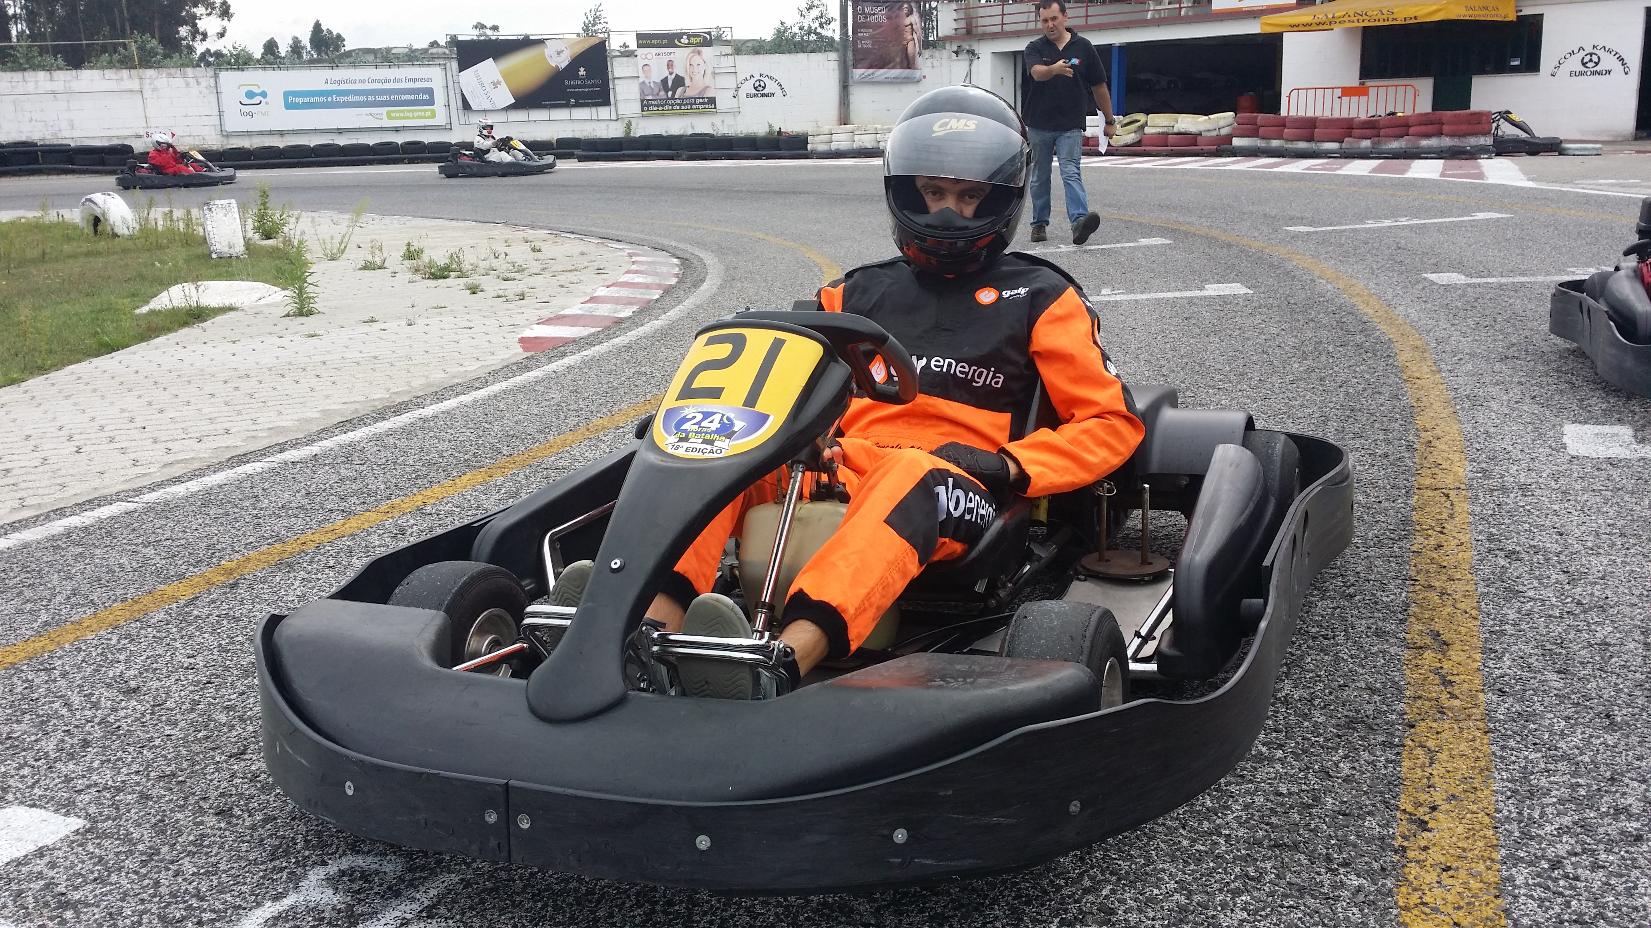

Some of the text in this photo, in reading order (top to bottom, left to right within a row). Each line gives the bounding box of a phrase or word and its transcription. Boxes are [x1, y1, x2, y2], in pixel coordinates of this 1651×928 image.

[1550, 44, 1631, 78] ESCOLA KARTING
[1569, 68, 1613, 78] EUROINDY
[288, 95, 327, 104] Preparamos
[332, 94, 367, 103] Expedimos
[390, 92, 430, 101] encomendas
[932, 118, 978, 132] CMS
[675, 332, 787, 409] 21
[930, 356, 1005, 388] energia
